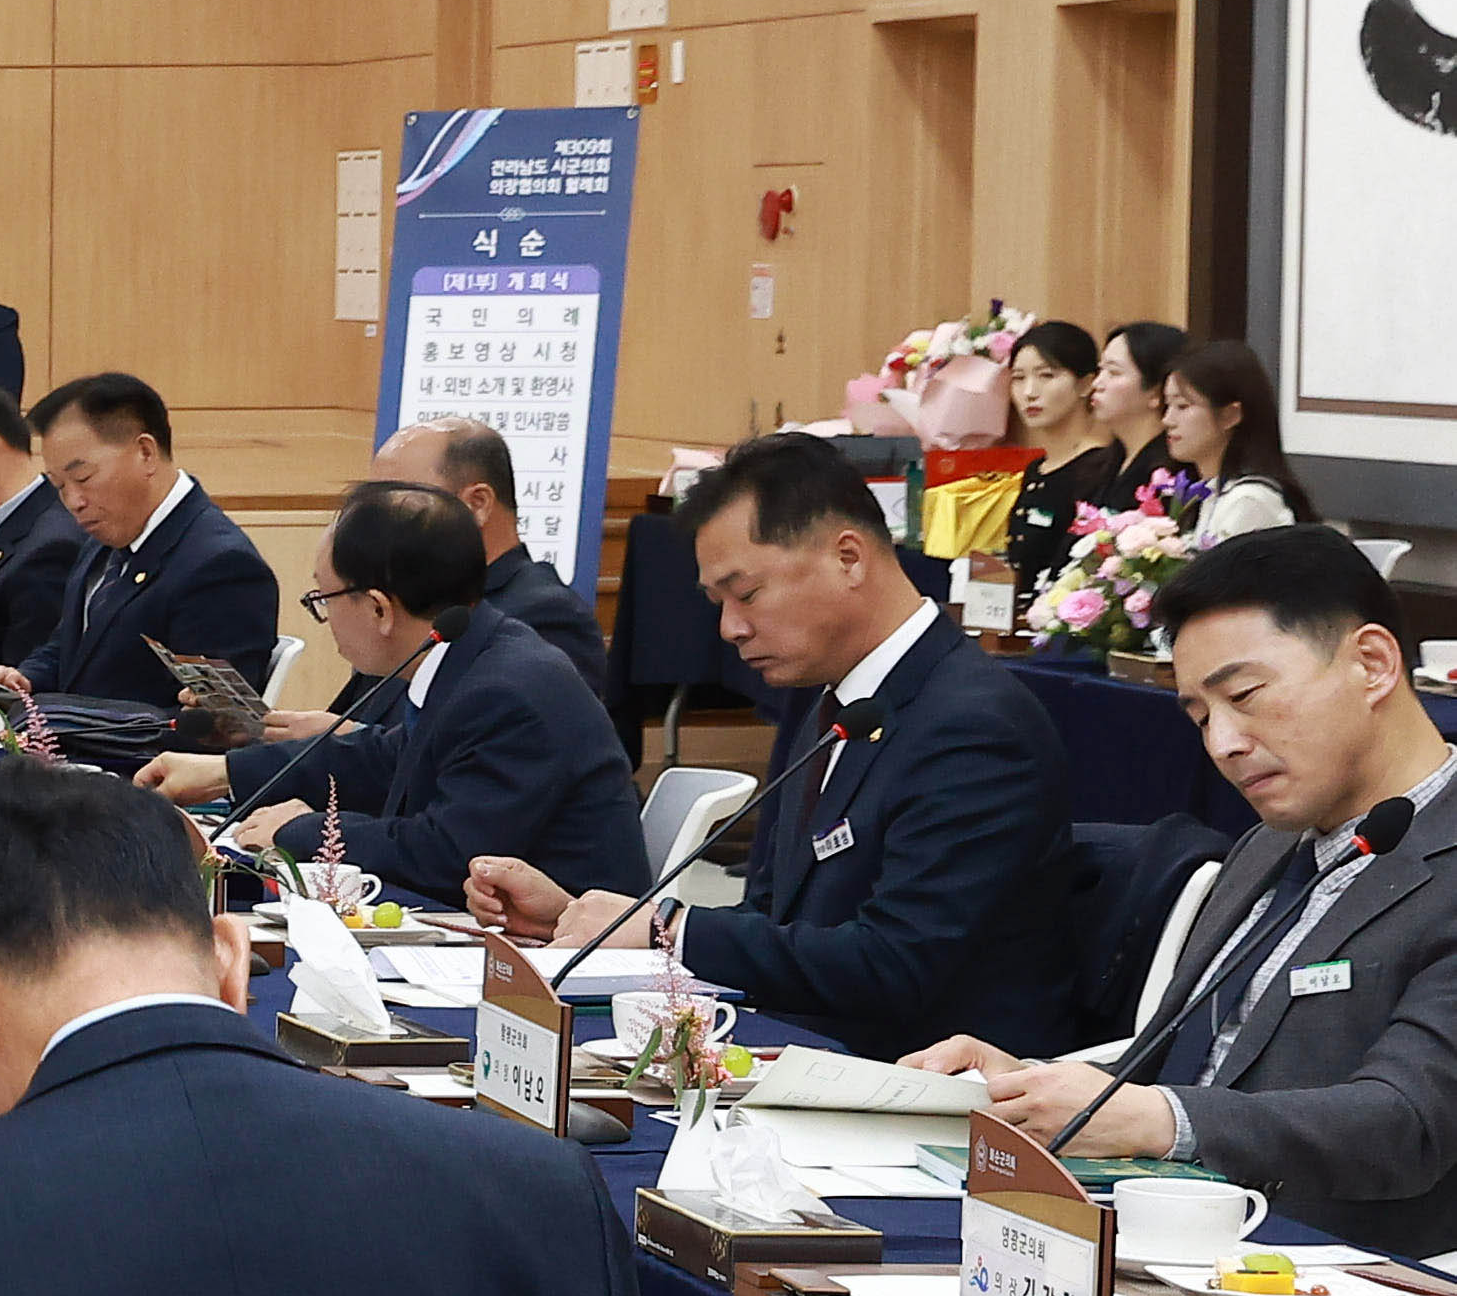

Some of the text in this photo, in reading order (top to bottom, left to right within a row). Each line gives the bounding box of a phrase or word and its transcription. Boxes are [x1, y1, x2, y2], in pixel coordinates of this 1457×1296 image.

[554, 138, 612, 155] 제309회
[491, 157, 611, 176] 전라남도 시군의회
[488, 177, 609, 195] 의장협의회 월례회
[478, 377, 506, 395] 소개
[512, 377, 525, 396] 및
[531, 376, 574, 396] 환영사
[514, 411, 570, 430] 인사말씀
